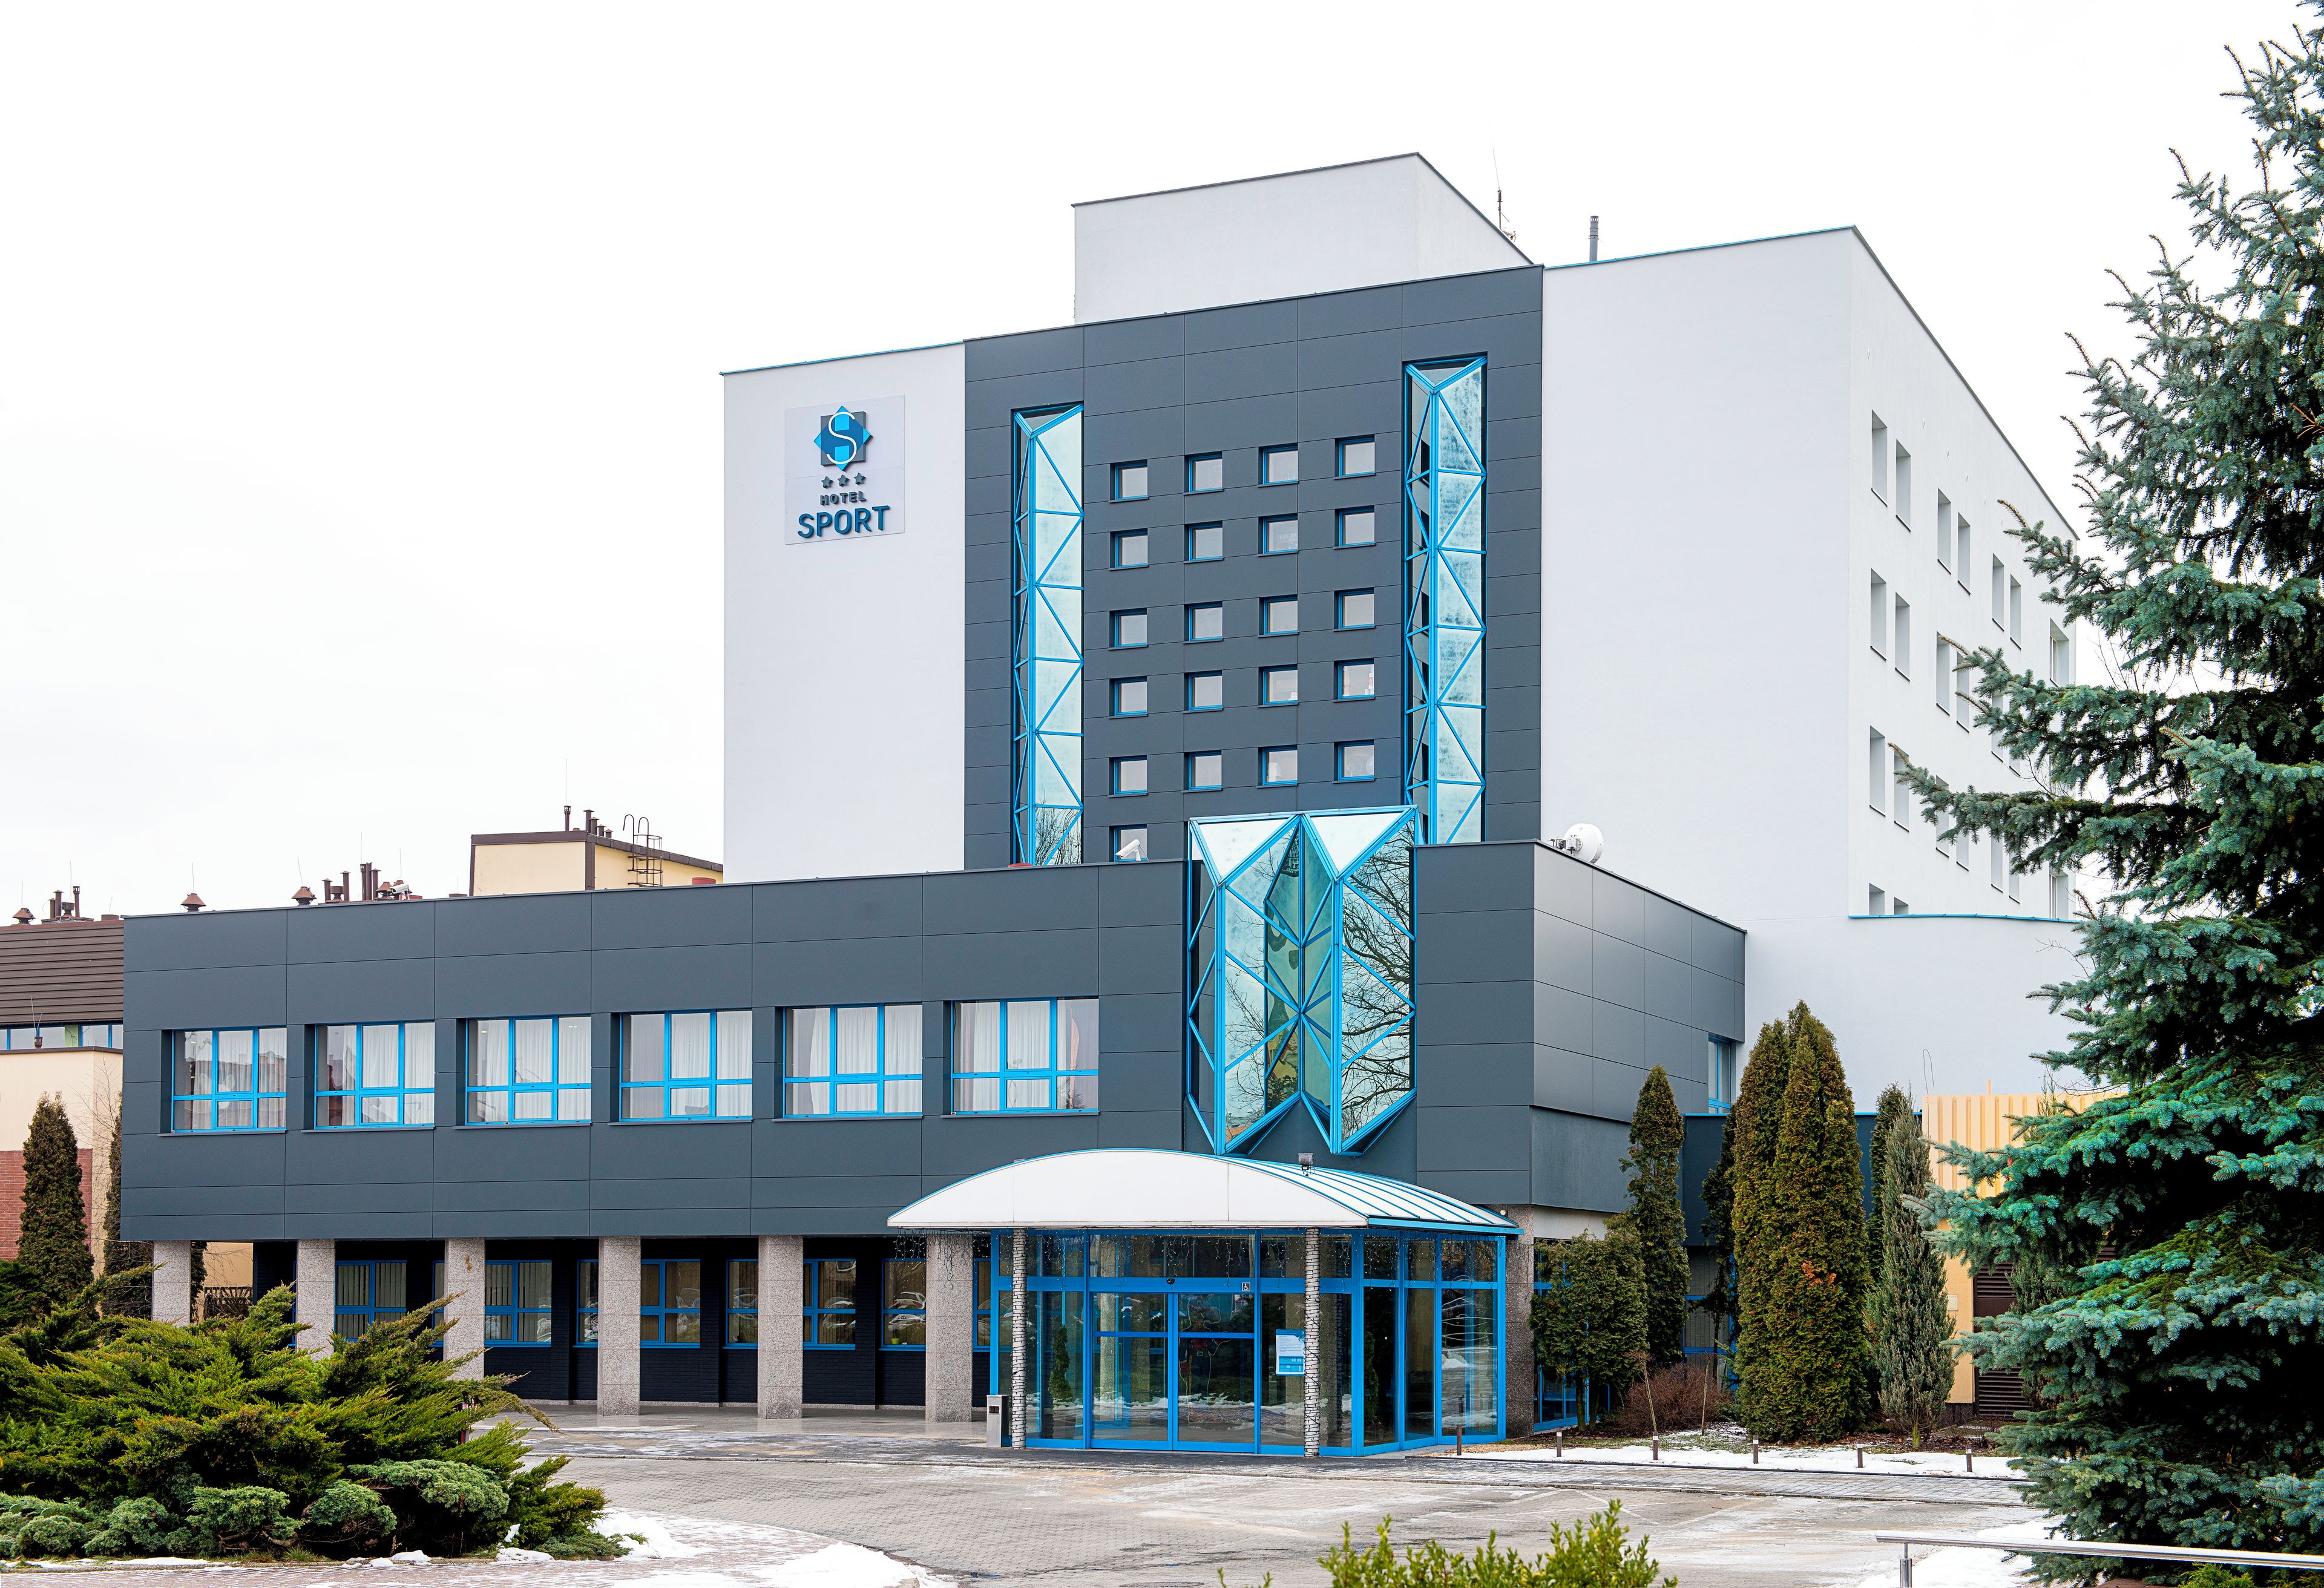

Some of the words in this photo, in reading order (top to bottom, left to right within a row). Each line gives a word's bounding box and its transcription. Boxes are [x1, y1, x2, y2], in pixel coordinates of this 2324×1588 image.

[826, 411, 857, 464] S
[820, 491, 867, 505] HOTEL
[797, 505, 890, 539] SPORT
